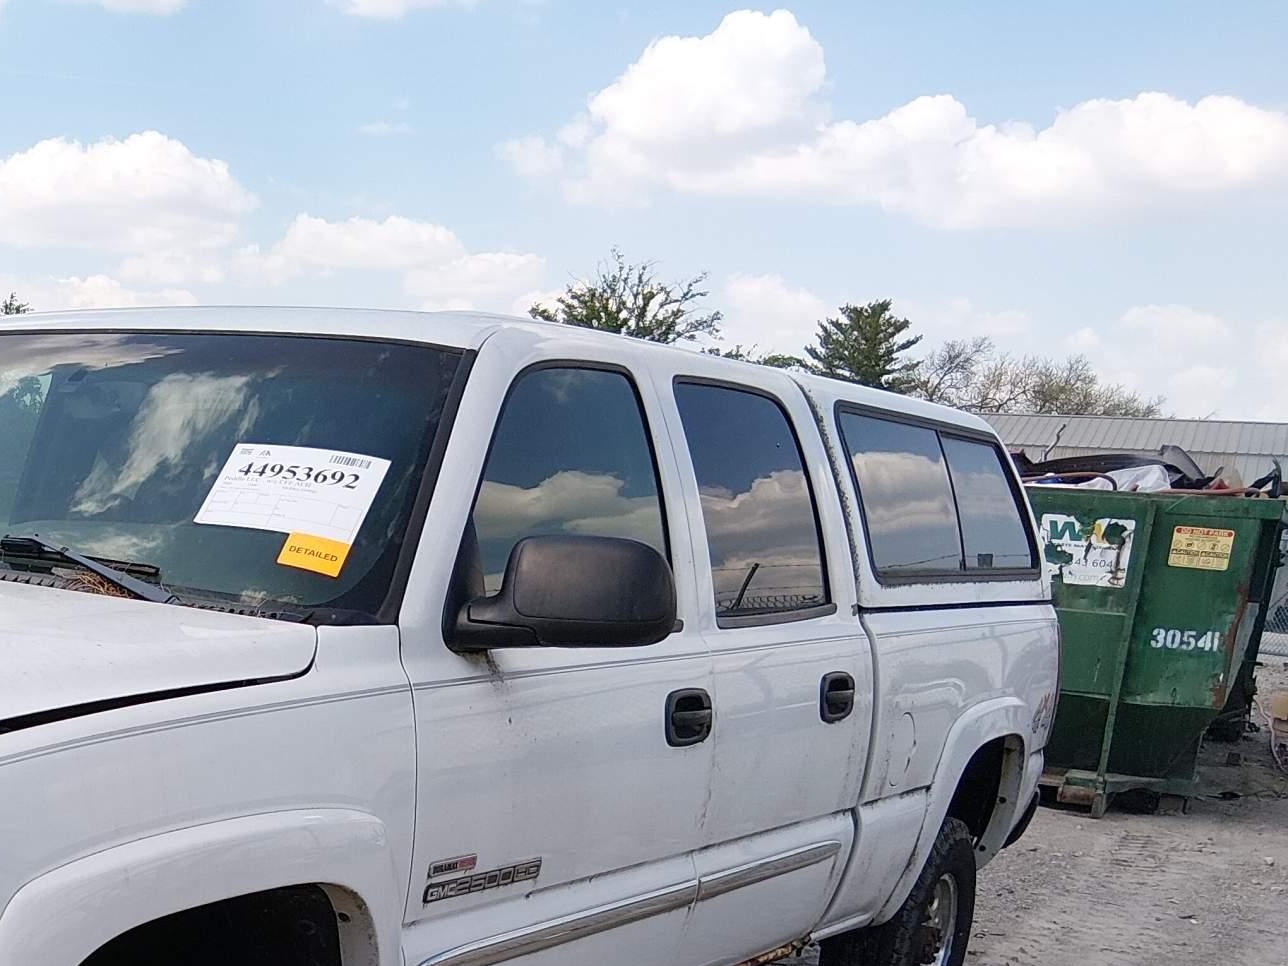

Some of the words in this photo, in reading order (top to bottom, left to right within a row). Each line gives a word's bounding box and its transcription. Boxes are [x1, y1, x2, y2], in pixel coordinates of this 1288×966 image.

[238, 461, 360, 490] 44953692
[288, 545, 338, 563] DETAILED
[1150, 627, 1220, 652] 30541
